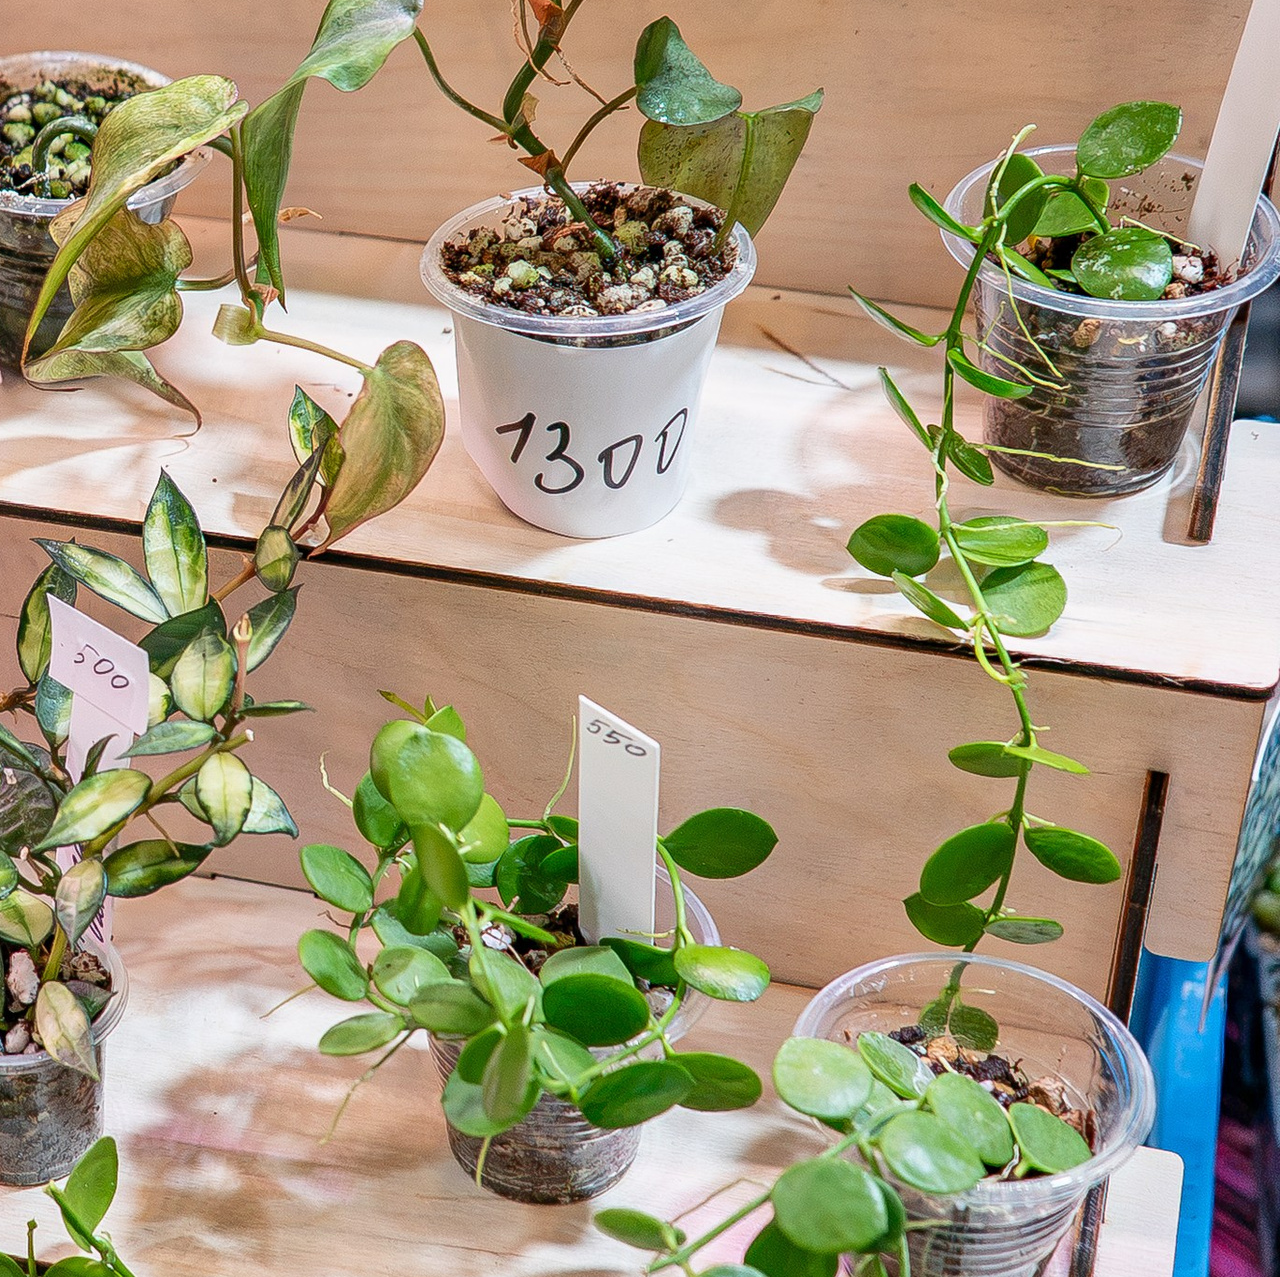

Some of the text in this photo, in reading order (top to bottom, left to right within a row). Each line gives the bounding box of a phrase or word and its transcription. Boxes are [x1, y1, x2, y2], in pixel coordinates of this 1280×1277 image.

[495, 408, 689, 495] 1300
[73, 643, 130, 691] 500
[586, 718, 647, 758] 550
